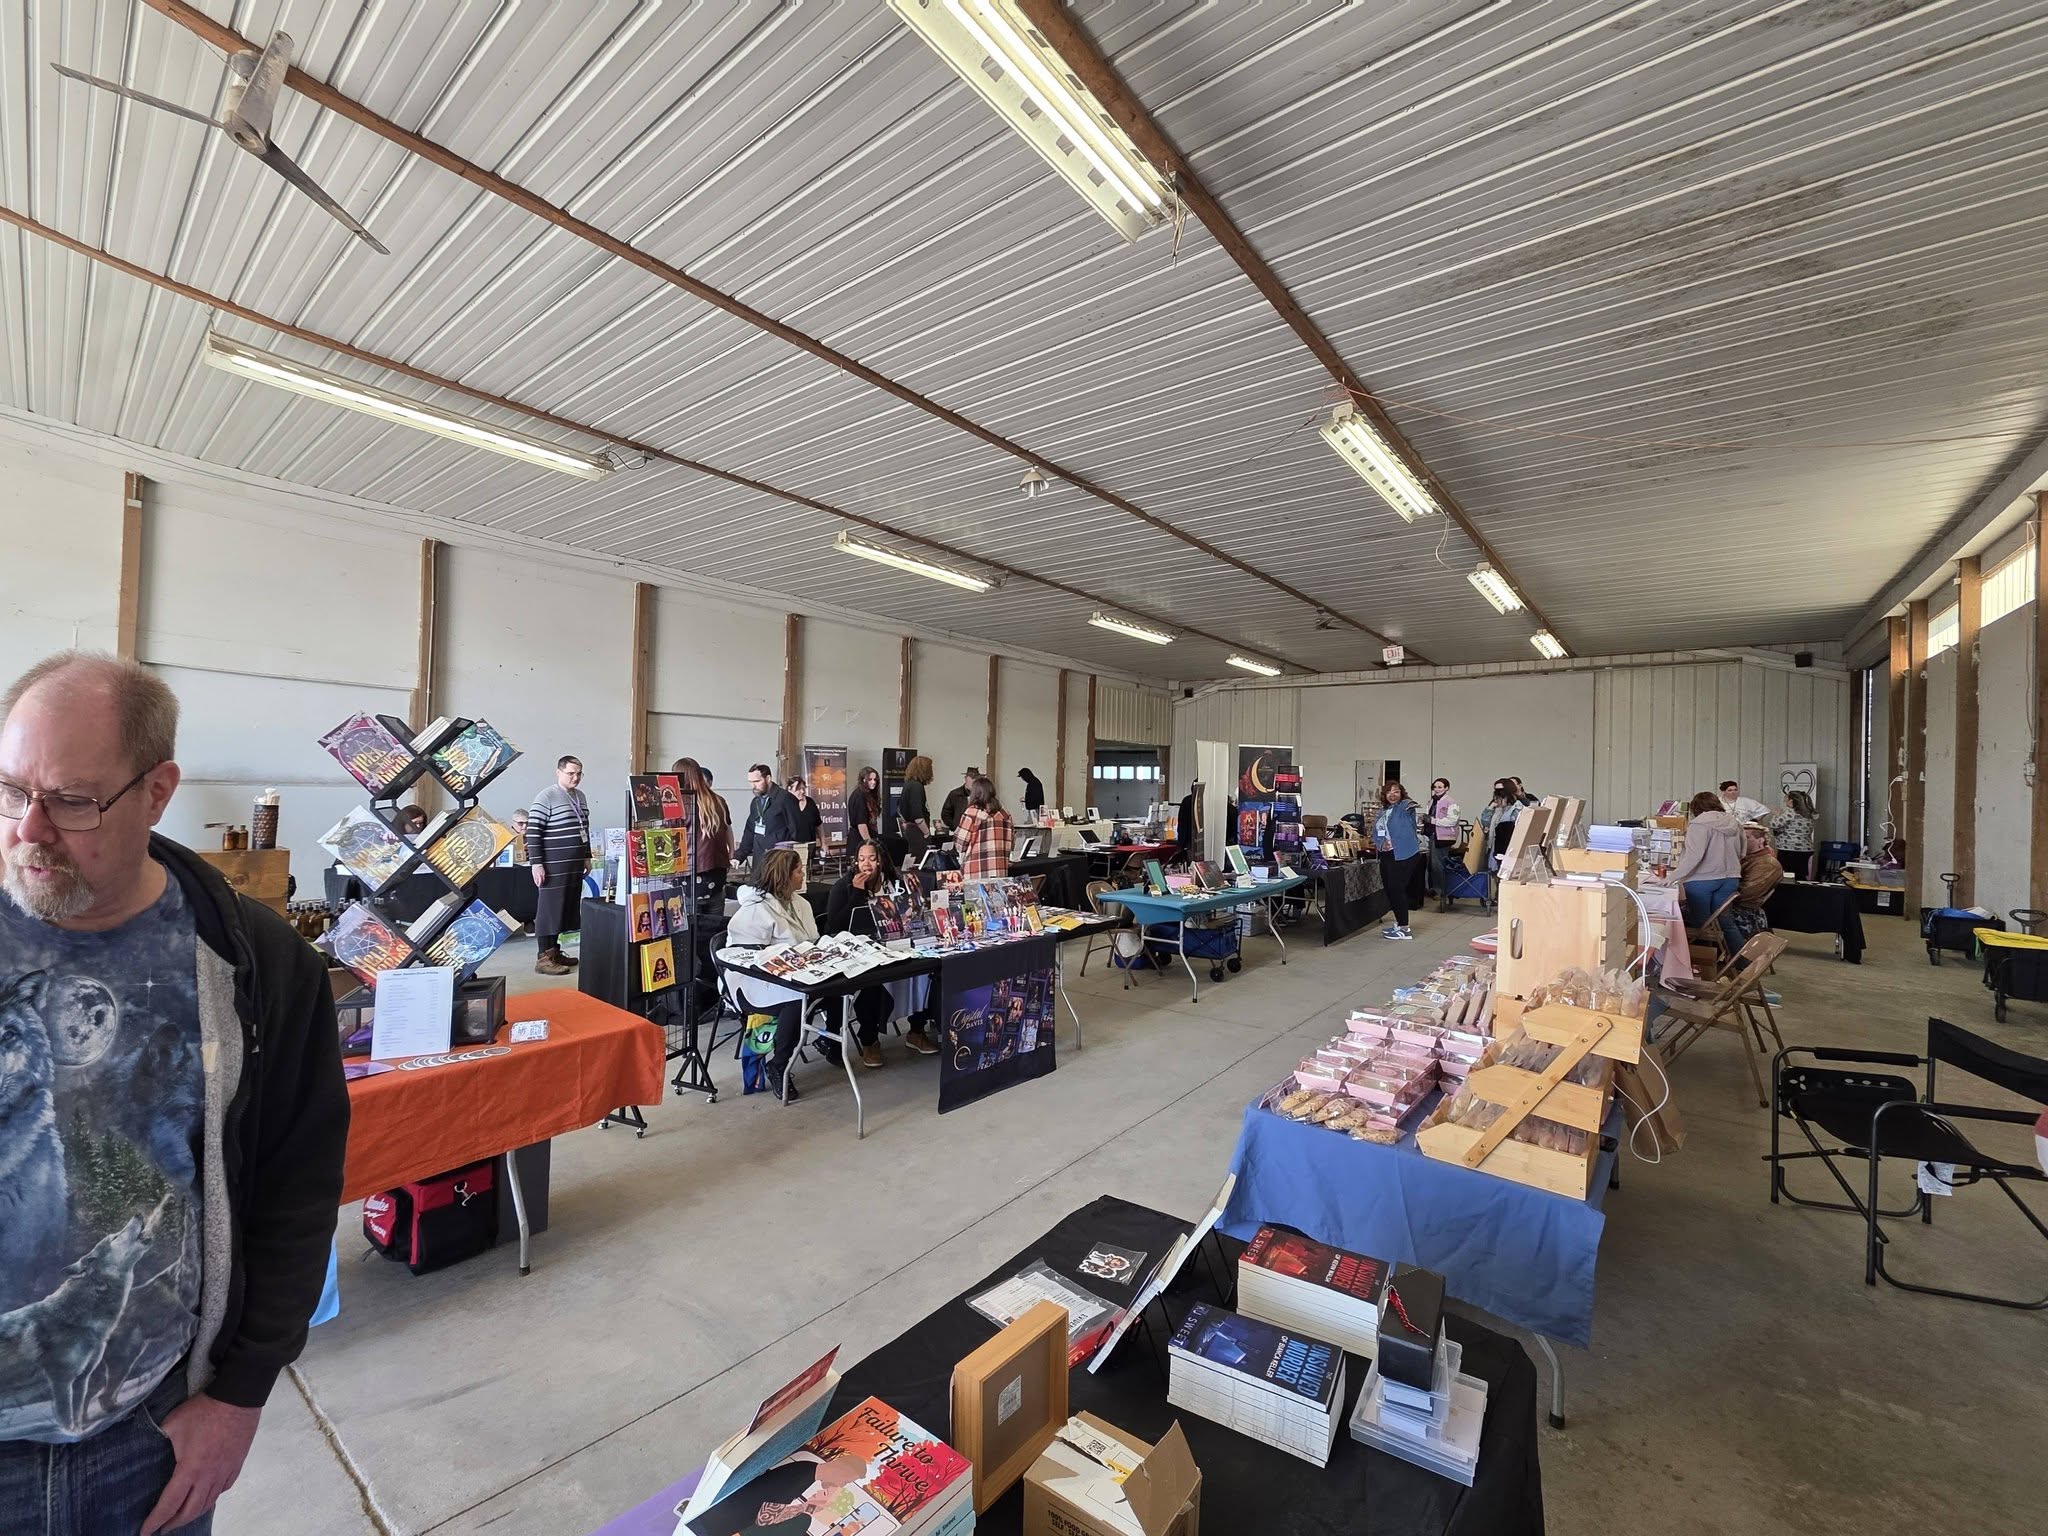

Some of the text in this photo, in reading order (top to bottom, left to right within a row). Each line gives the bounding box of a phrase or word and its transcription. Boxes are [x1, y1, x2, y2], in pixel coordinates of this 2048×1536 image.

[817, 788, 840, 797] Things
[821, 801, 831, 809] Do
[841, 801, 847, 809] A
[1331, 1255, 1361, 1289] MURDER
[1350, 1259, 1379, 1299] UNSOLVED
[1173, 1317, 1198, 1346] SWEET
[1265, 1335, 1289, 1378] OF BIANCA KELLER
[1275, 1339, 1309, 1384] MURDER
[1297, 1344, 1332, 1397] UNSOLVED
[858, 1407, 934, 1465] Failure to
[873, 1442, 930, 1493] Thrive
[1064, 1519, 1081, 1534] FOOD
